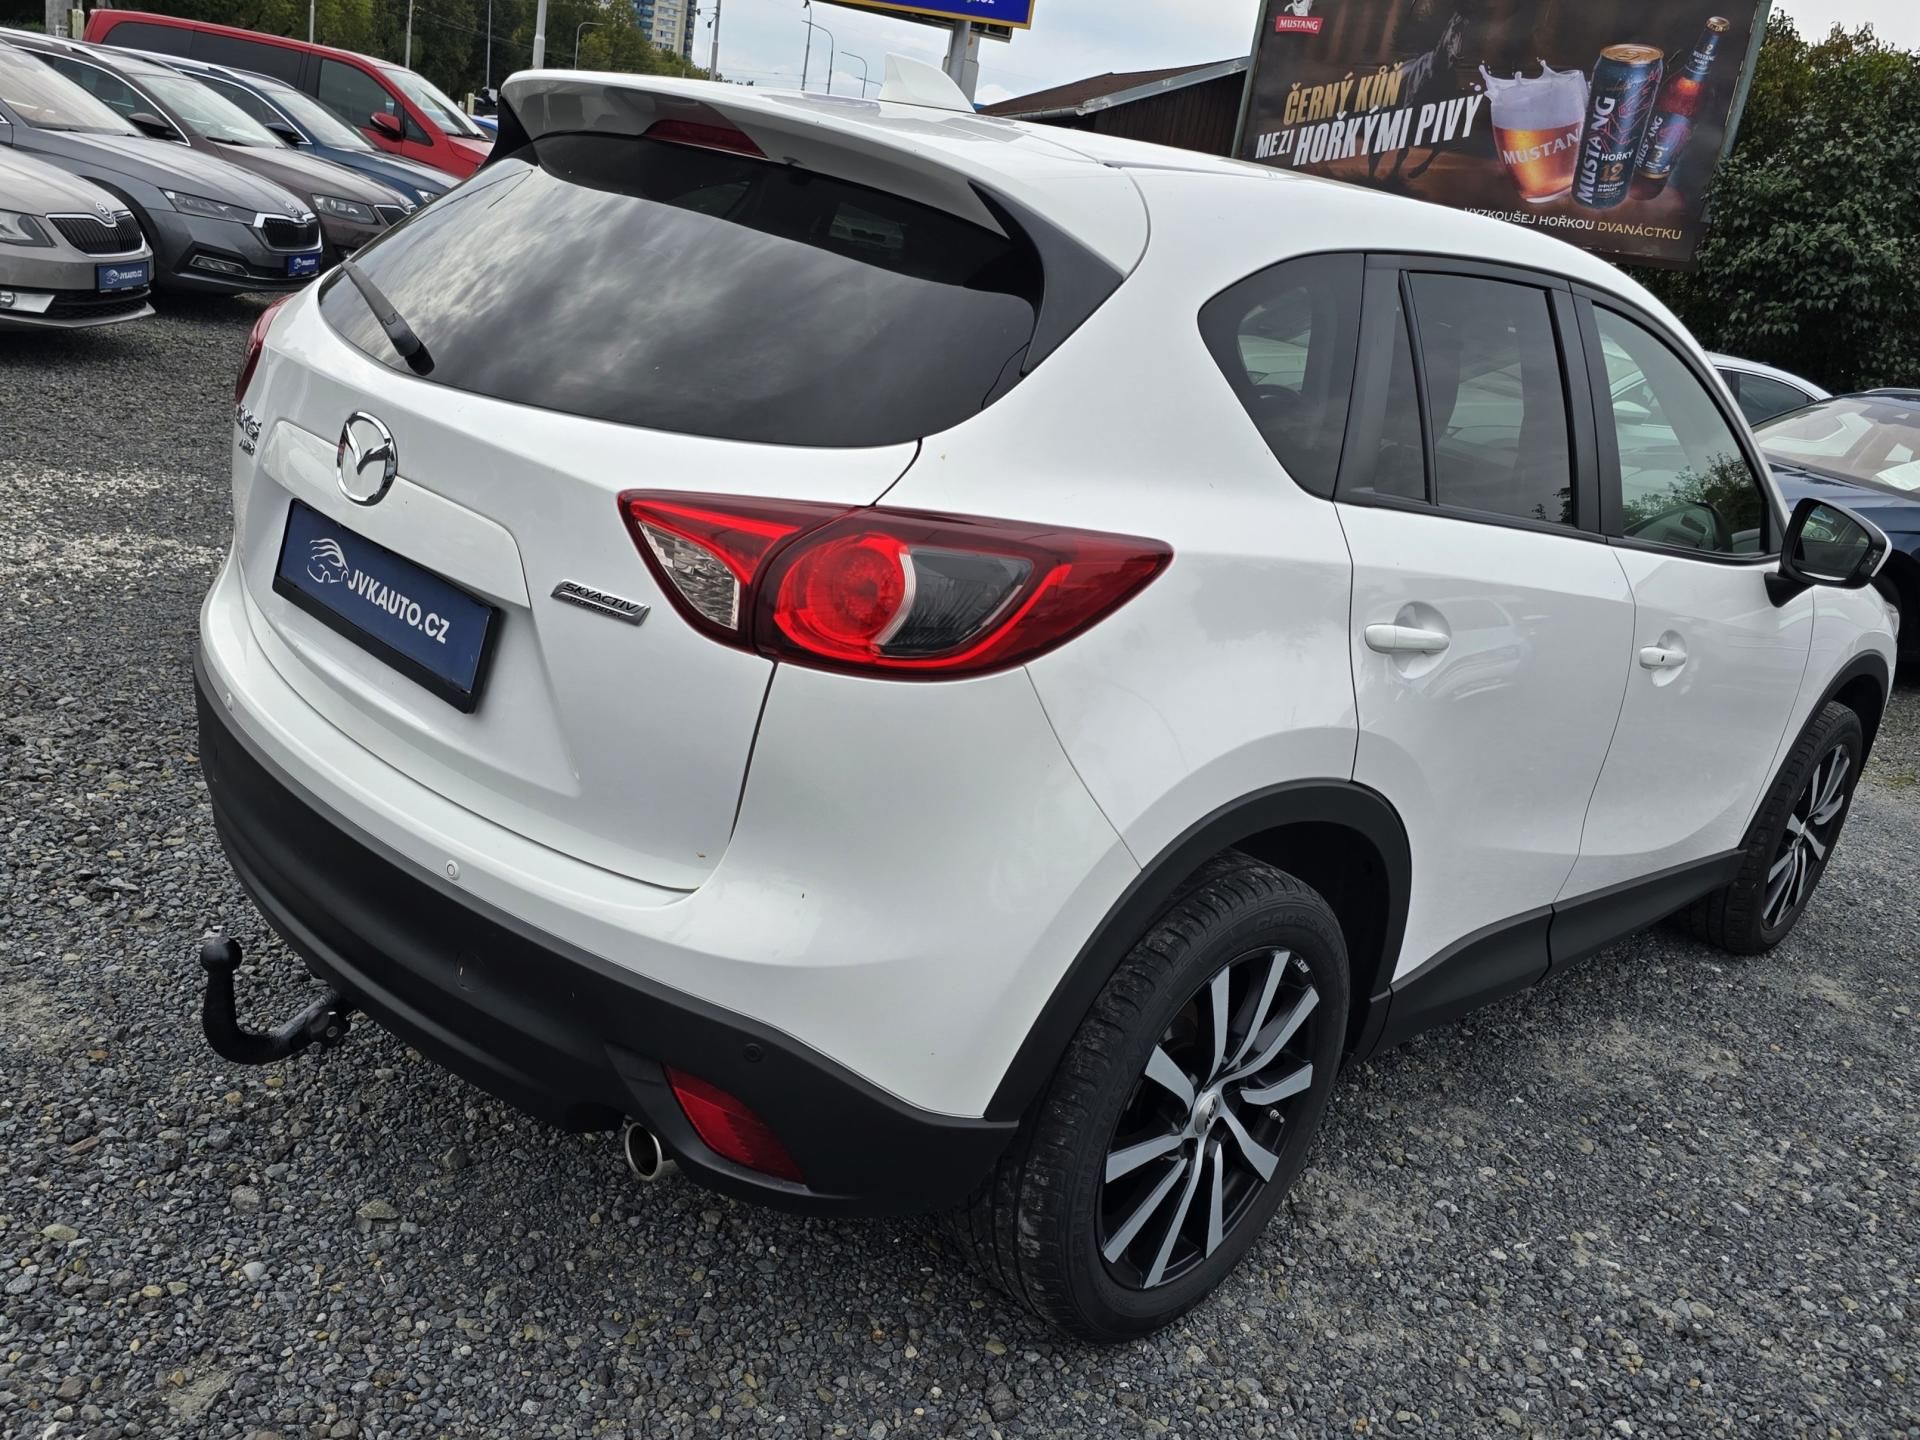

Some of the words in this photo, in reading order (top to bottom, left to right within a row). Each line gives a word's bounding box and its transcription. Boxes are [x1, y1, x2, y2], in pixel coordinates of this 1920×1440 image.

[1279, 19, 1318, 31] MUSTANG
[1283, 72, 1354, 126] ČERNÝ
[1354, 62, 1404, 113] KŮŇ
[1255, 129, 1295, 159] MEZI
[1292, 105, 1413, 167] HOŘKÝMI
[1414, 94, 1484, 147] PIVY
[1503, 127, 1580, 165] MUSTAN
[1576, 96, 1616, 204] MUSTANG
[1600, 163, 1624, 182] 12
[1539, 214, 1595, 230] HOŘKOU
[1597, 222, 1682, 240] DVANÁCTKU
[347, 568, 450, 644] JVKAUTO.CZ
[563, 583, 639, 611] SKYACTIV
